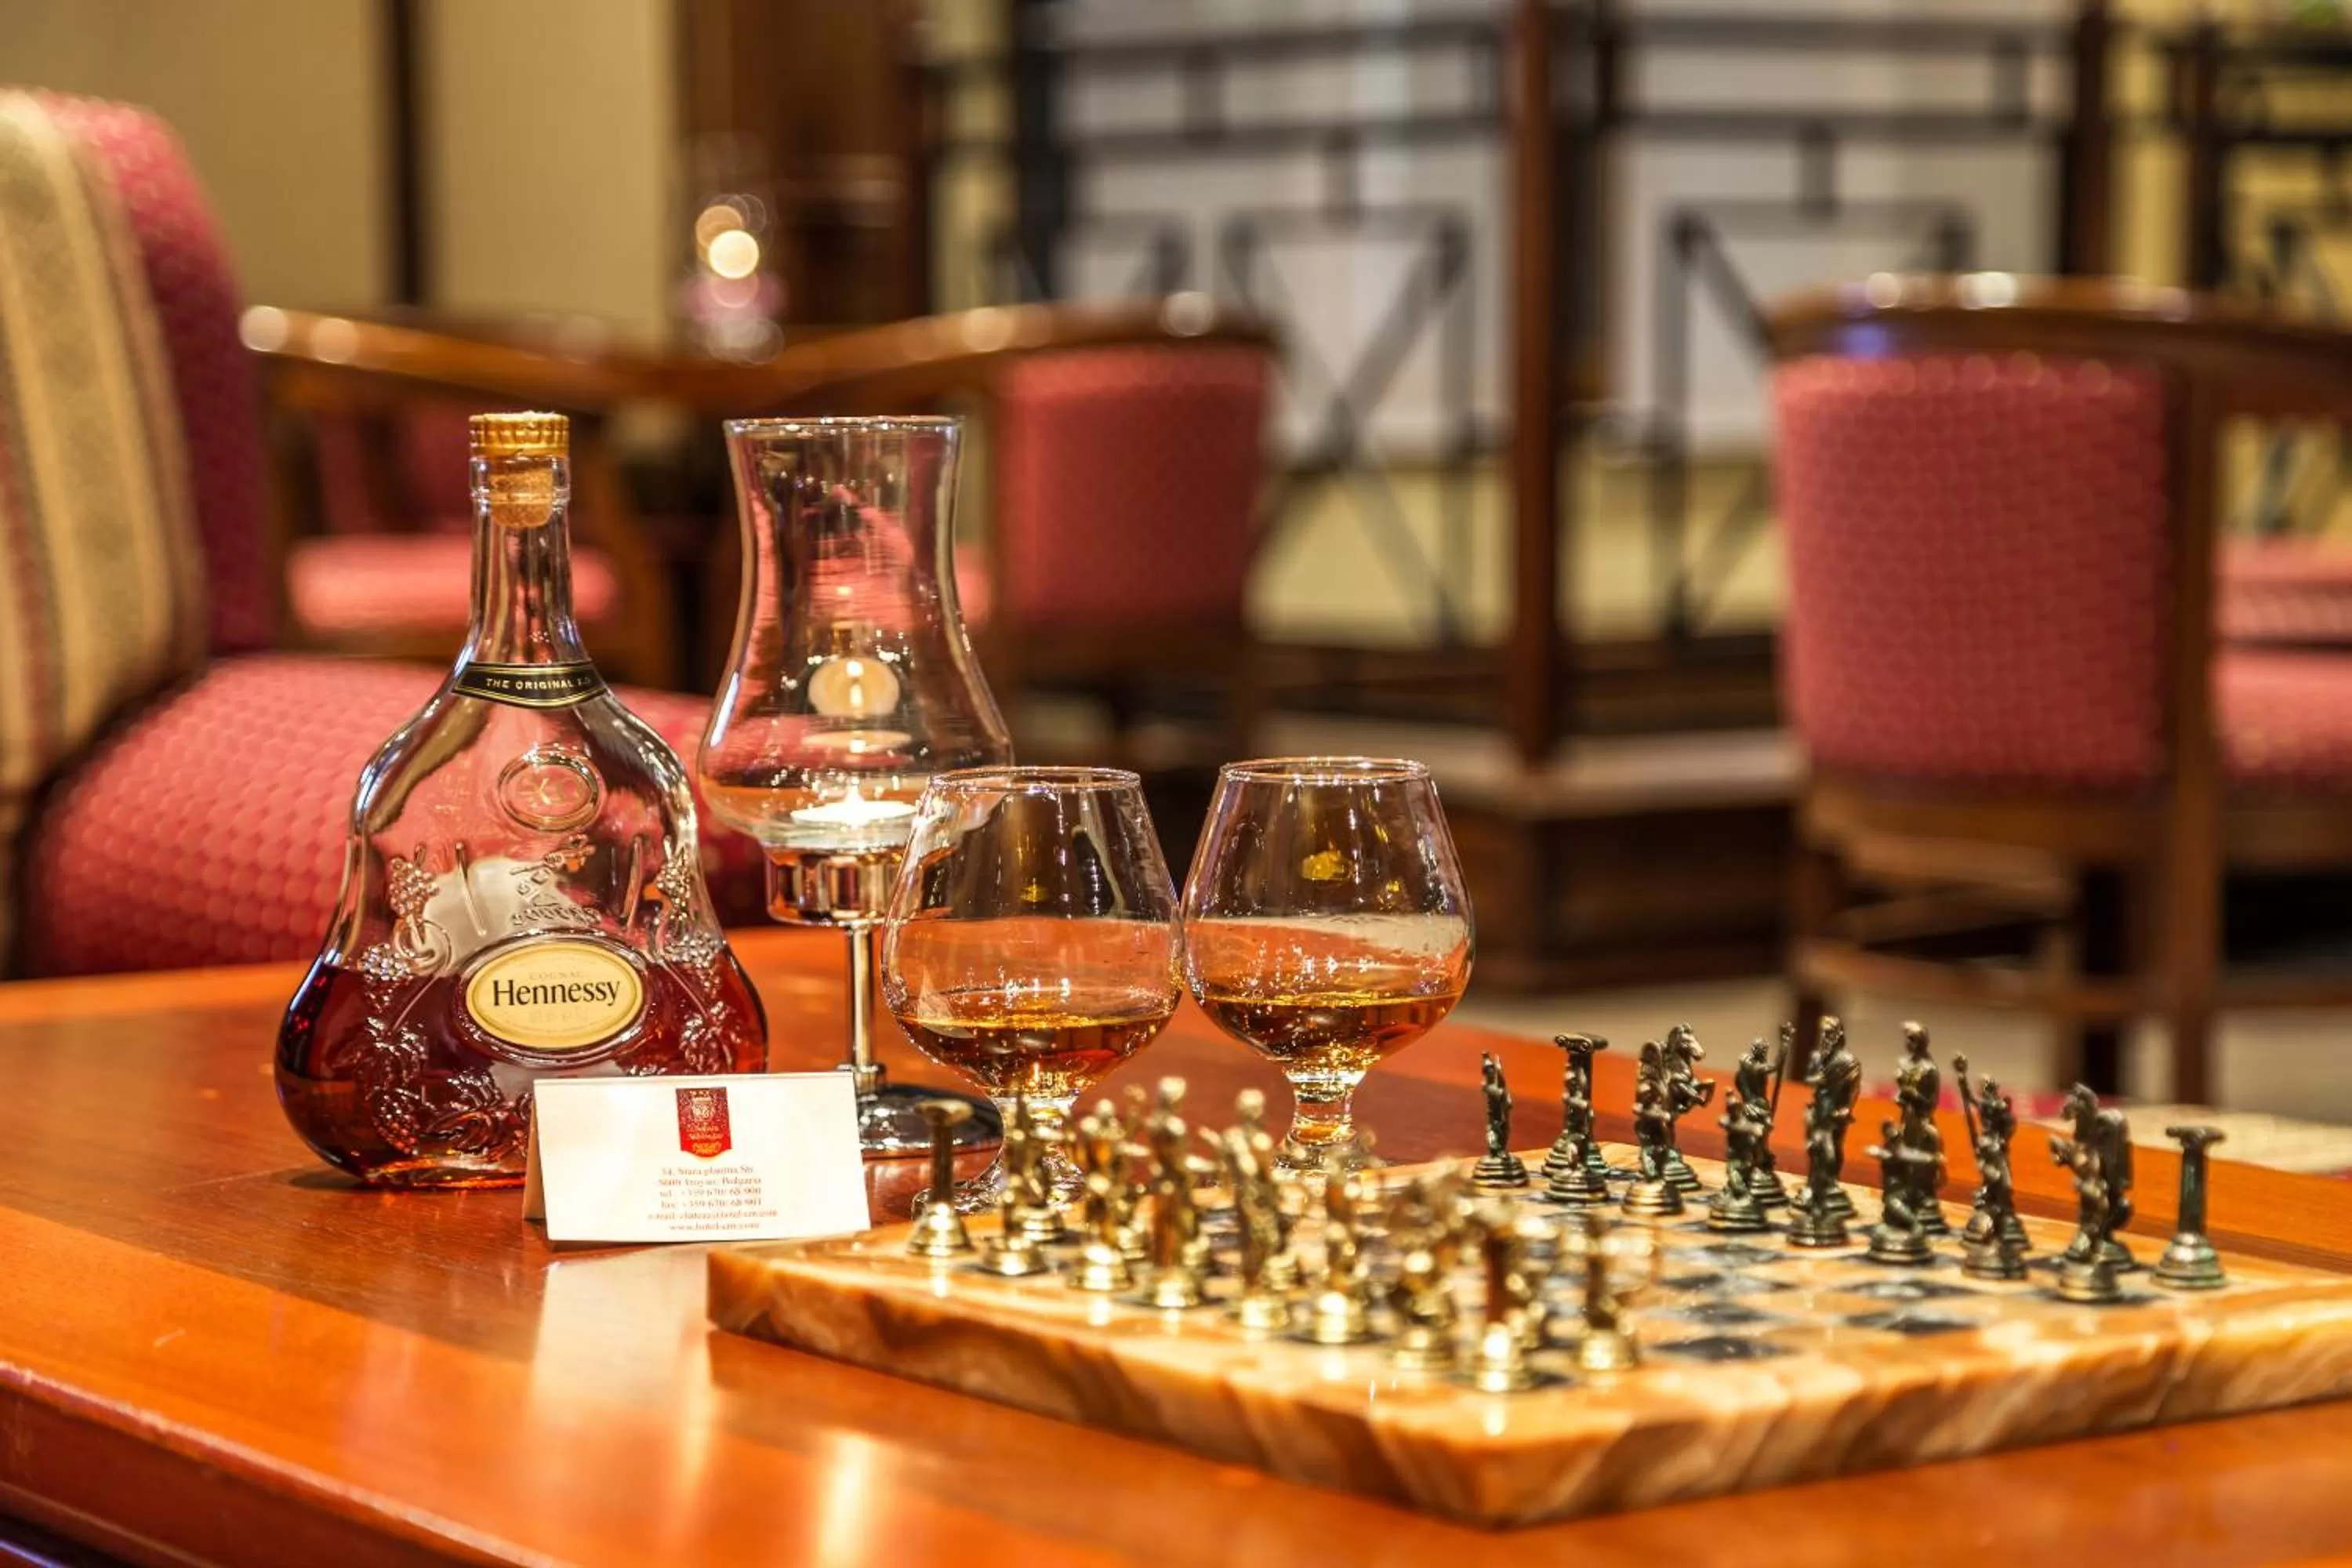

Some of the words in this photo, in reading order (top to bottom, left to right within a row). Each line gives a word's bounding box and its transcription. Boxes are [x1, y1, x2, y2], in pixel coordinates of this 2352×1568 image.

[485, 678, 510, 688] THE
[515, 679, 574, 690] ORIGINAL
[492, 979, 620, 1007] Hennessy
